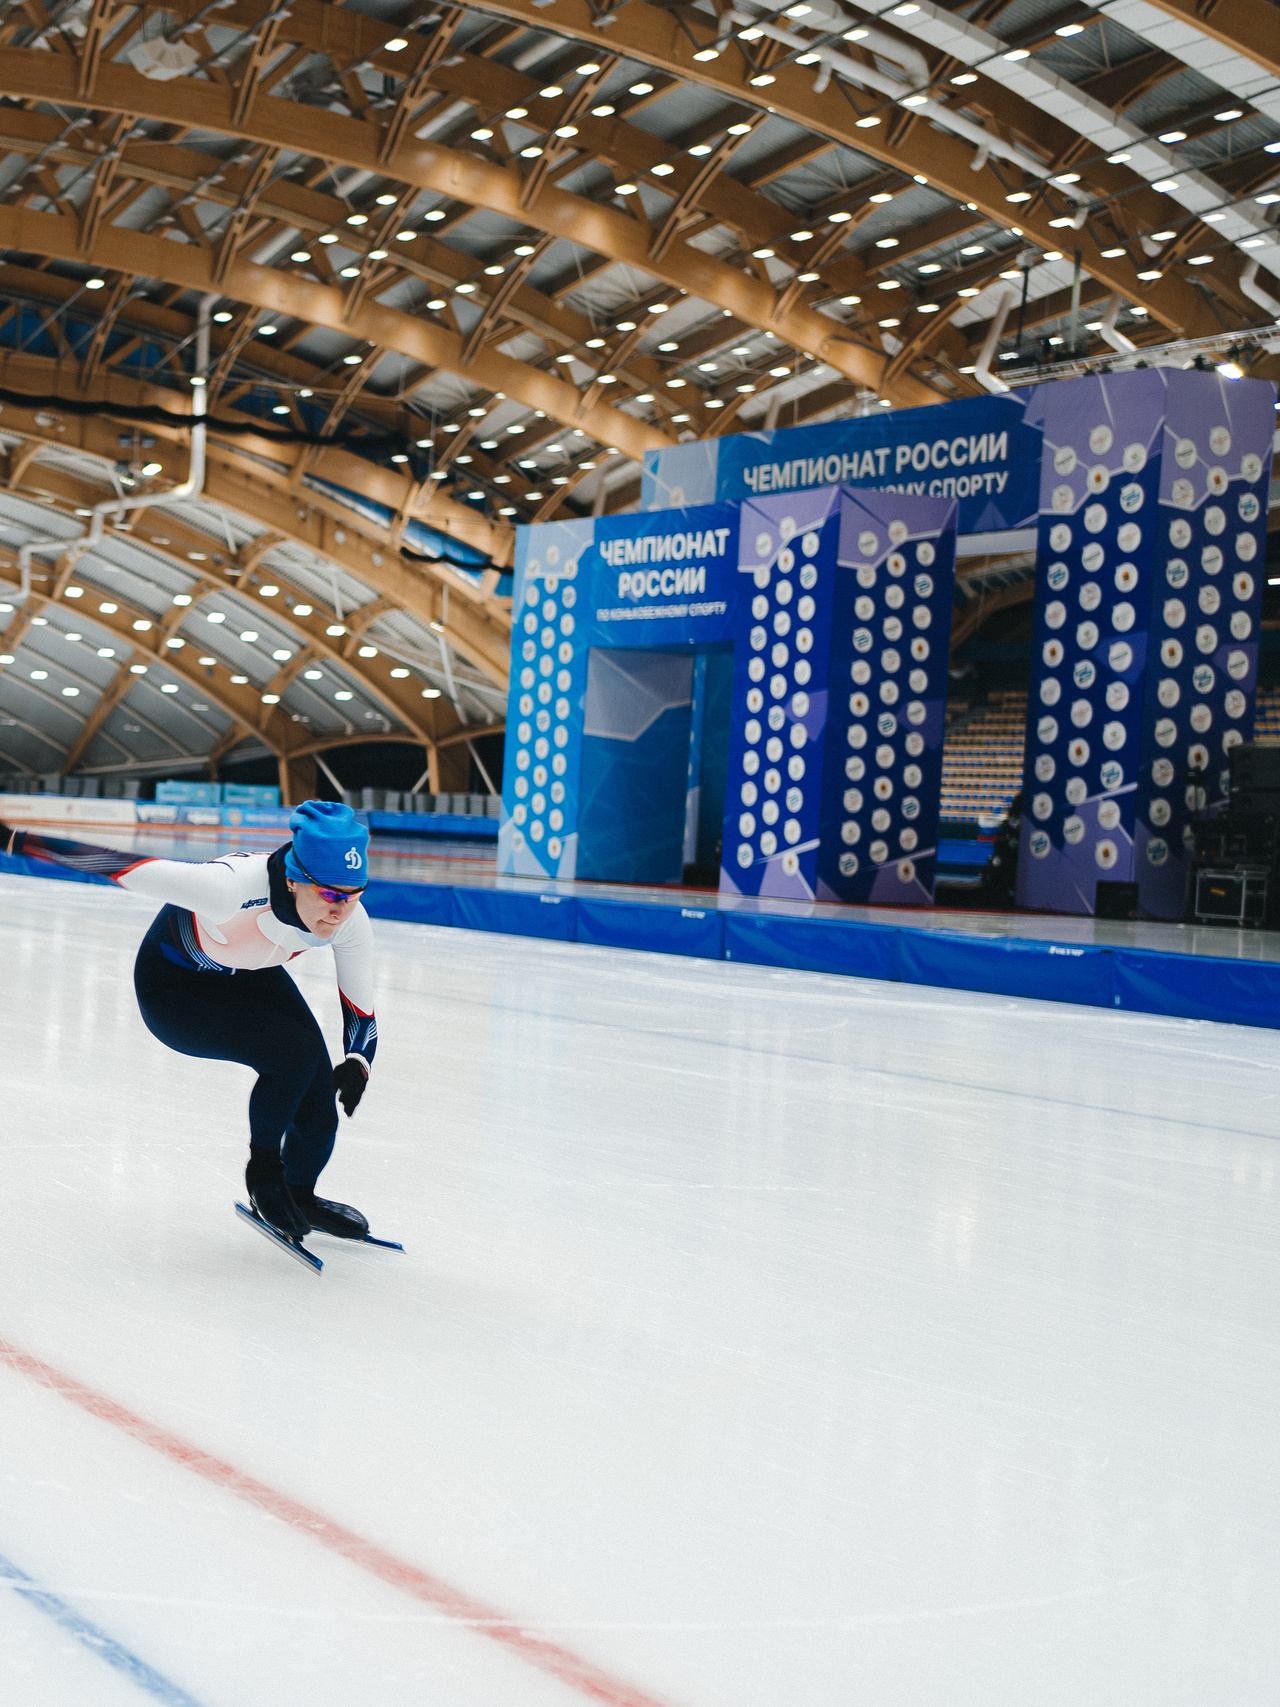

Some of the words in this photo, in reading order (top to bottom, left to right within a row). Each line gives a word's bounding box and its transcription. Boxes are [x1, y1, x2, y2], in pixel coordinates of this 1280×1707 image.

[743, 448, 891, 492] ЧЕМПИОНАТ
[895, 431, 1008, 474] РОССИИ
[928, 471, 1008, 498] СПОРТУ
[600, 528, 730, 566] ЧЕМПИОНАТ
[618, 566, 706, 599] РОССИИ
